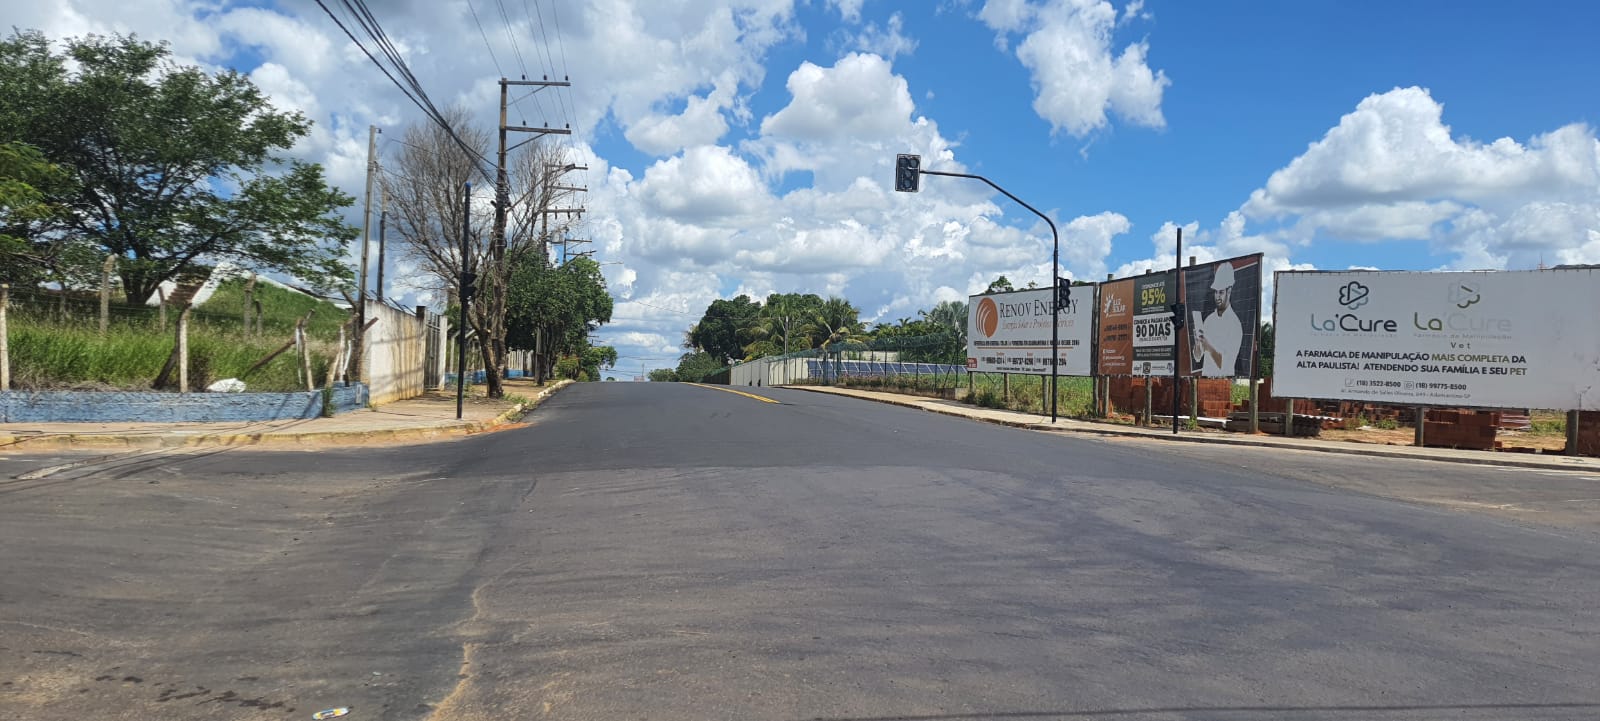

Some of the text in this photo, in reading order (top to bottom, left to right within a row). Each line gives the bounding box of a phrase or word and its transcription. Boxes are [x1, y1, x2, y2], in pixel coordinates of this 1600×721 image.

[1142, 287, 1166, 306] 95%
[1000, 303, 1031, 318] RENOV
[1136, 325, 1148, 338] 90
[1149, 322, 1171, 337] DIAS
[1311, 313, 1398, 332] La'Cure
[1348, 351, 1360, 359] DE
[1361, 351, 1430, 363] MANIPULAÇÃO
[1431, 353, 1456, 362] MAIS
[1457, 354, 1510, 363] COMPLETA
[1511, 355, 1527, 363] DA
[1297, 361, 1528, 376] ALTA PAULISTA! ATENDENDO SUA FAMÍLIA E SEU PET
